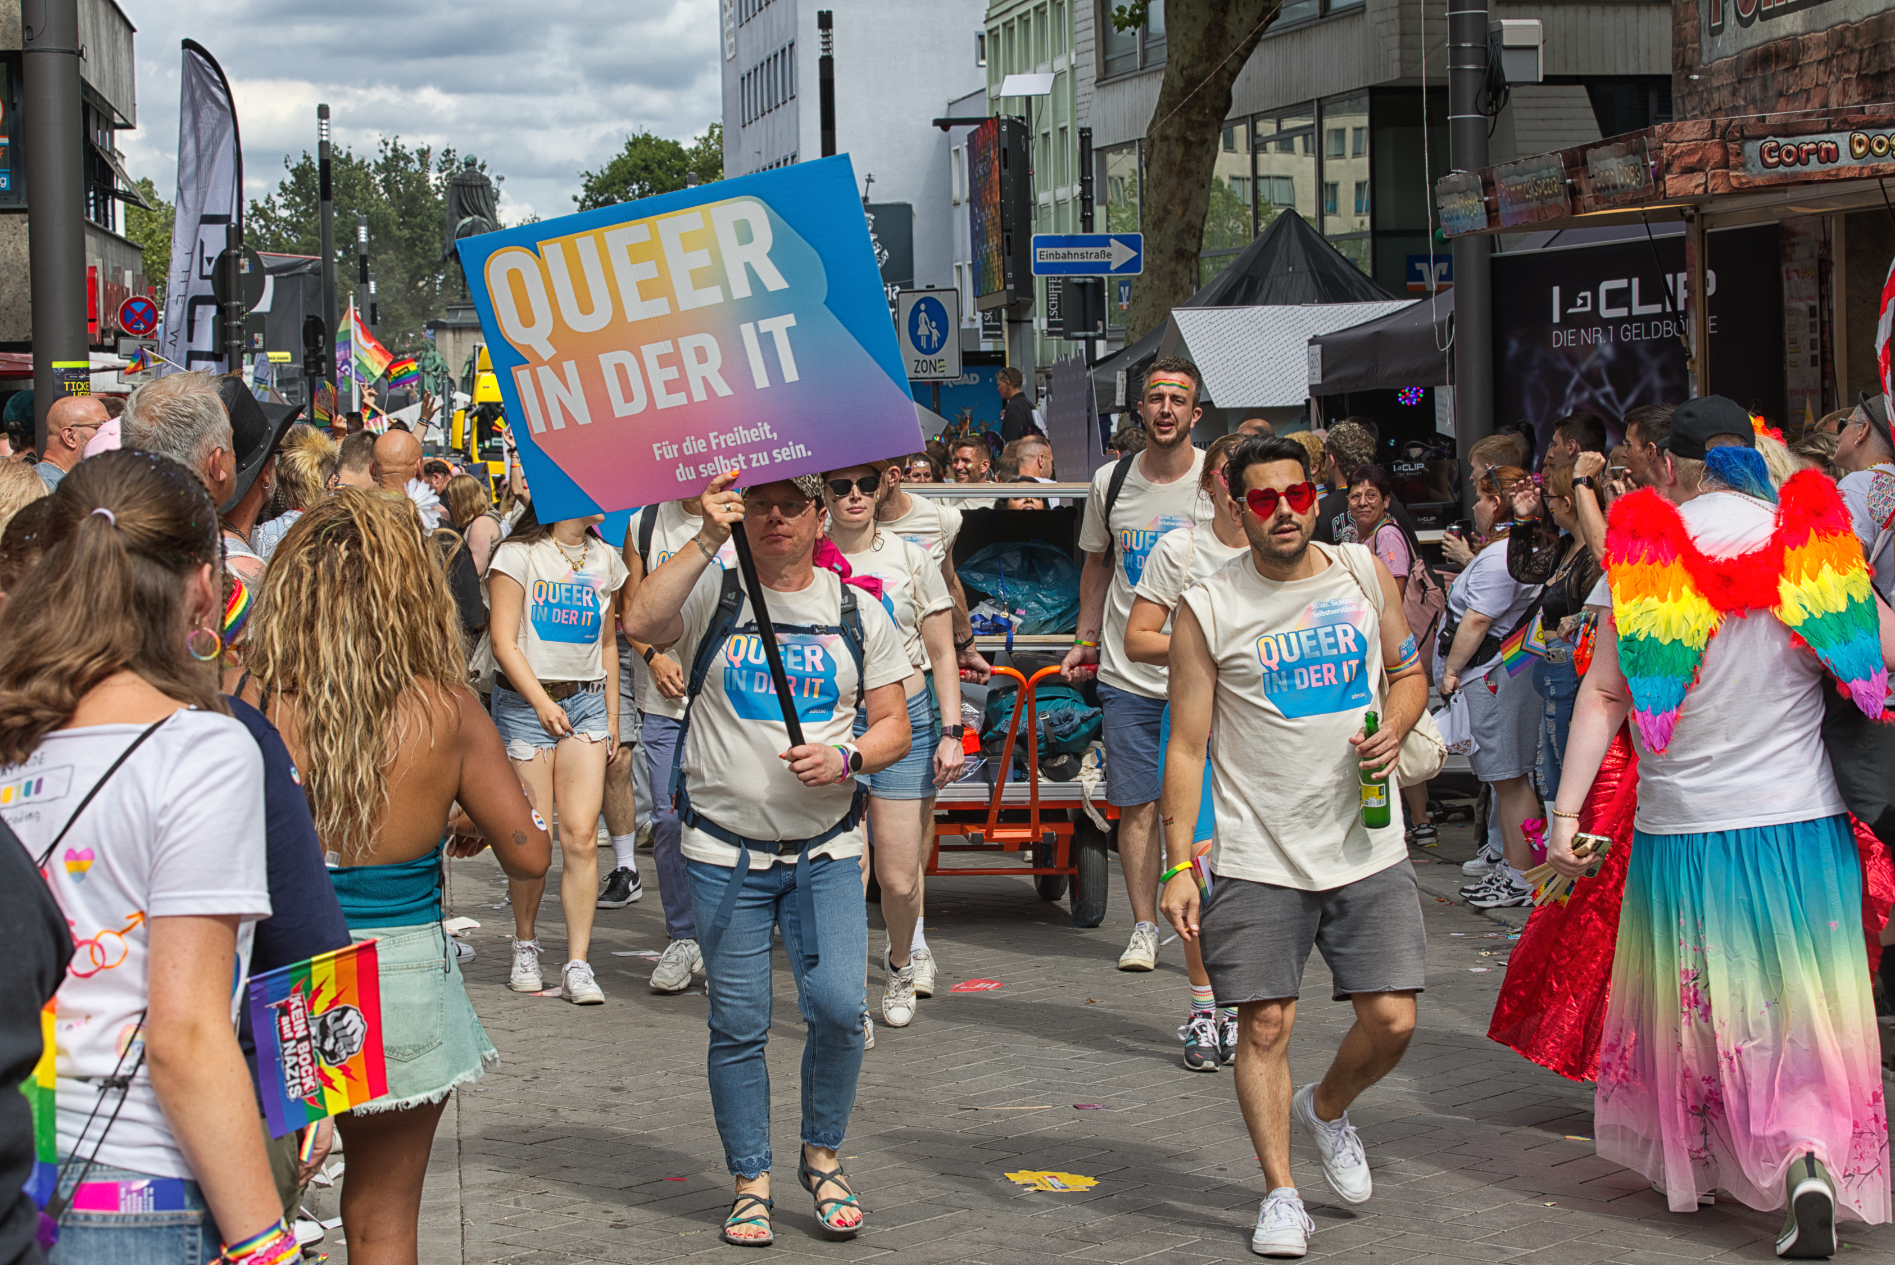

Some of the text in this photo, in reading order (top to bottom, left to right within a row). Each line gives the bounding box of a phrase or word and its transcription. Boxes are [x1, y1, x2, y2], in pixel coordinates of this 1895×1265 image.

[1760, 140, 1839, 169] Corn
[1616, 162, 1643, 190] Dogs
[1039, 250, 1112, 260] Einbahnstraße
[488, 200, 790, 362] QUEER
[1552, 329, 1577, 348] DIE
[1620, 315, 1718, 342] GELDBÖE
[517, 313, 800, 434] IN DER IT
[653, 421, 778, 461] Für die Freiheit,
[675, 440, 812, 482] du selbst zu sein.
[1120, 529, 1166, 553] QUE
[1123, 552, 1134, 568] IN
[533, 580, 594, 608] QUEER
[531, 605, 594, 627] IN DER IT
[1257, 623, 1359, 672] QUEER
[725, 668, 747, 692] IN
[803, 677, 825, 699] IT
[1263, 659, 1360, 695] IN DER IT
[289, 995, 317, 1093] KEIN BOCK
[283, 1040, 303, 1101] NAZIS
